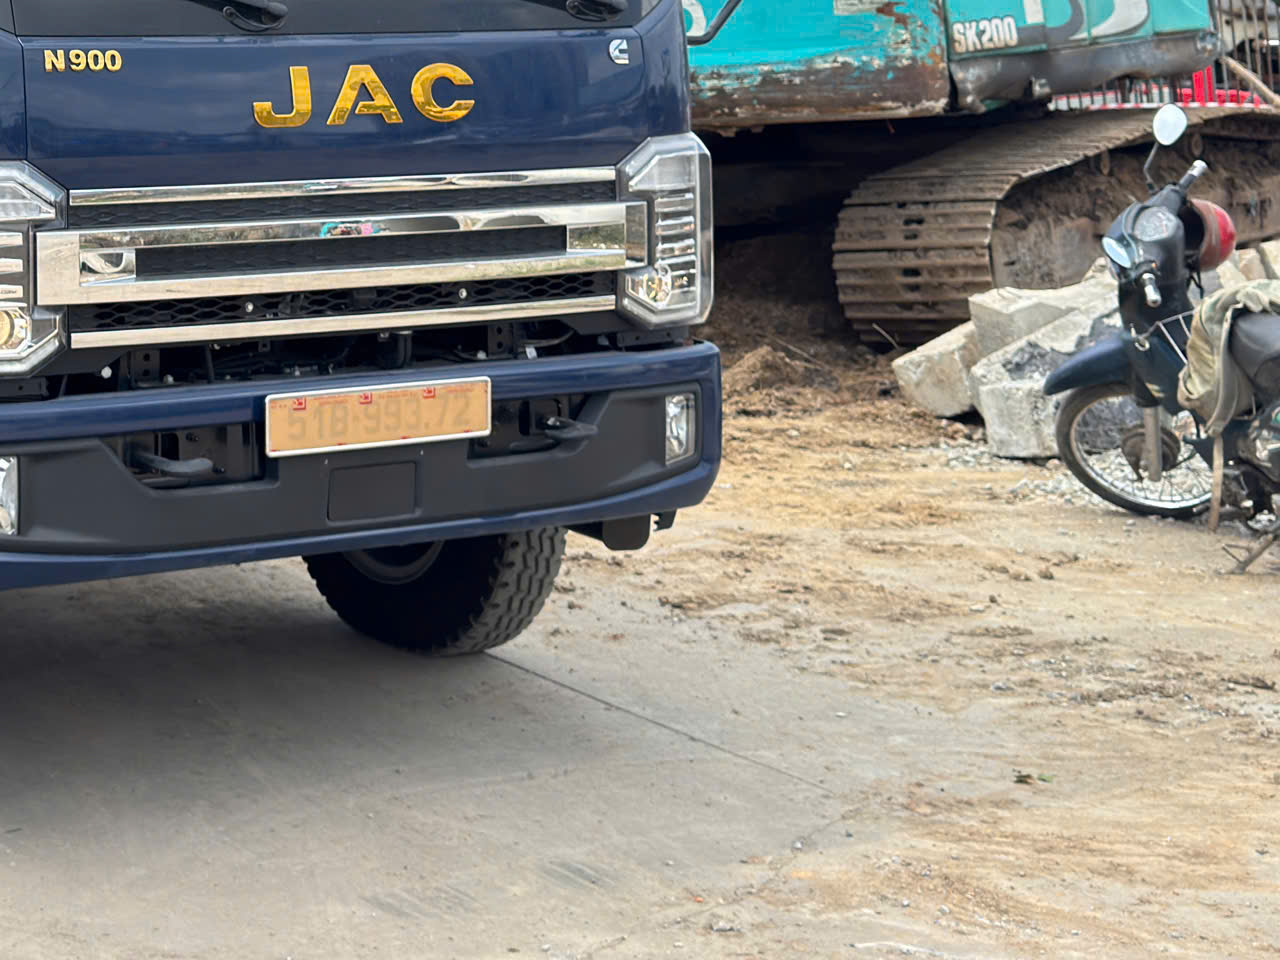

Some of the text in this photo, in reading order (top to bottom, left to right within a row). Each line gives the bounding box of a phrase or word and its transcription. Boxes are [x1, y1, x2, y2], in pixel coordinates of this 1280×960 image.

[952, 15, 1019, 54] SK200
[44, 49, 122, 72] N900
[253, 62, 475, 127] JAC
